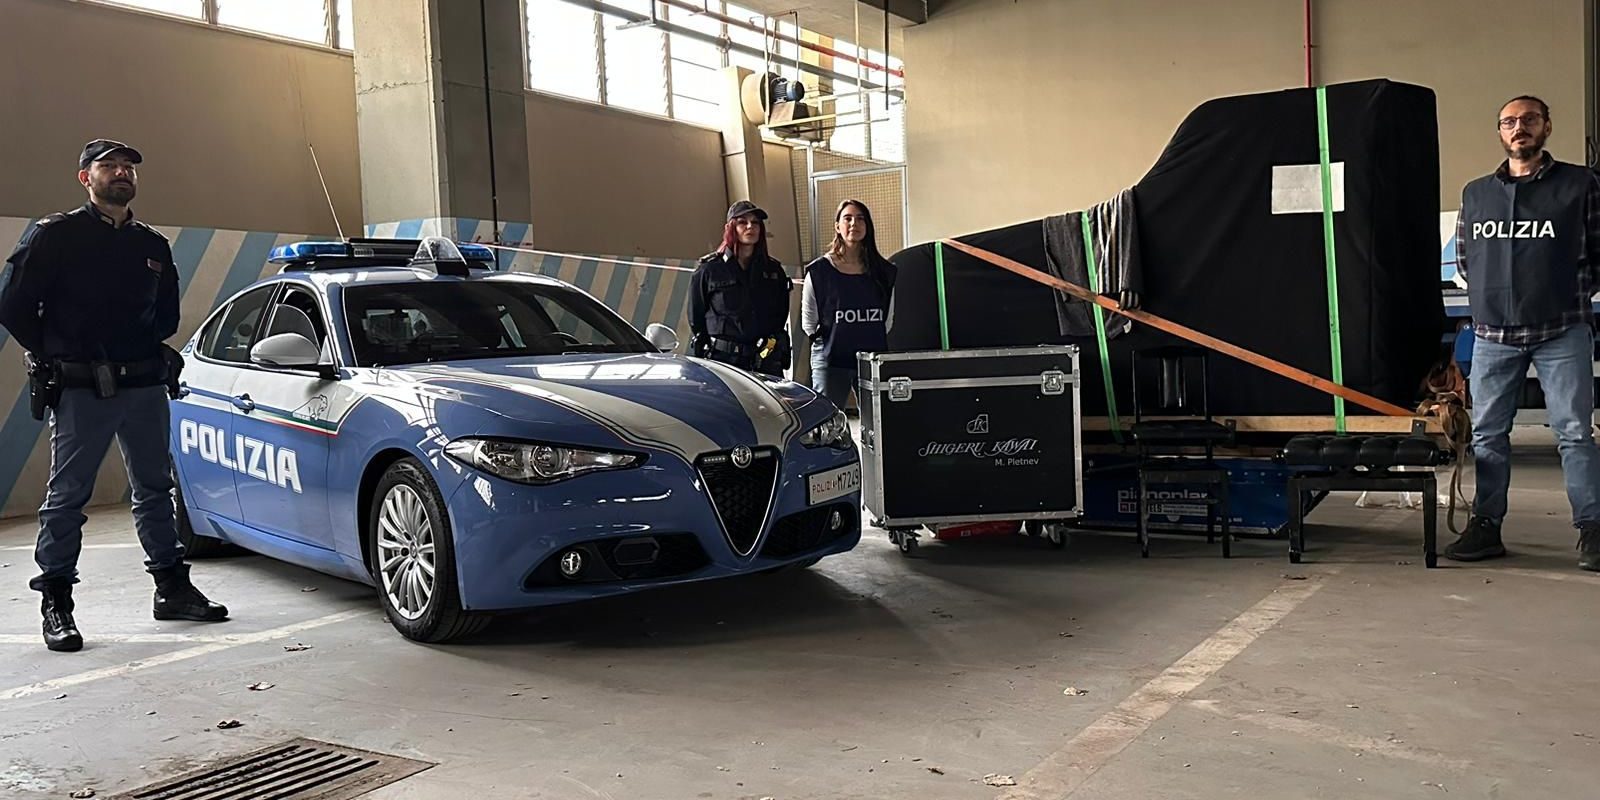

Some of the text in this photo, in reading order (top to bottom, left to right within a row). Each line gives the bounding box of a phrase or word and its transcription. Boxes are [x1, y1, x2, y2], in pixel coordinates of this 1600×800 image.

[1472, 220, 1555, 240] POLIZIA
[180, 418, 303, 494] POLIZIA
[918, 438, 1038, 458] SHIGERU KAWAI
[994, 457, 1039, 466] M. Pletnev
